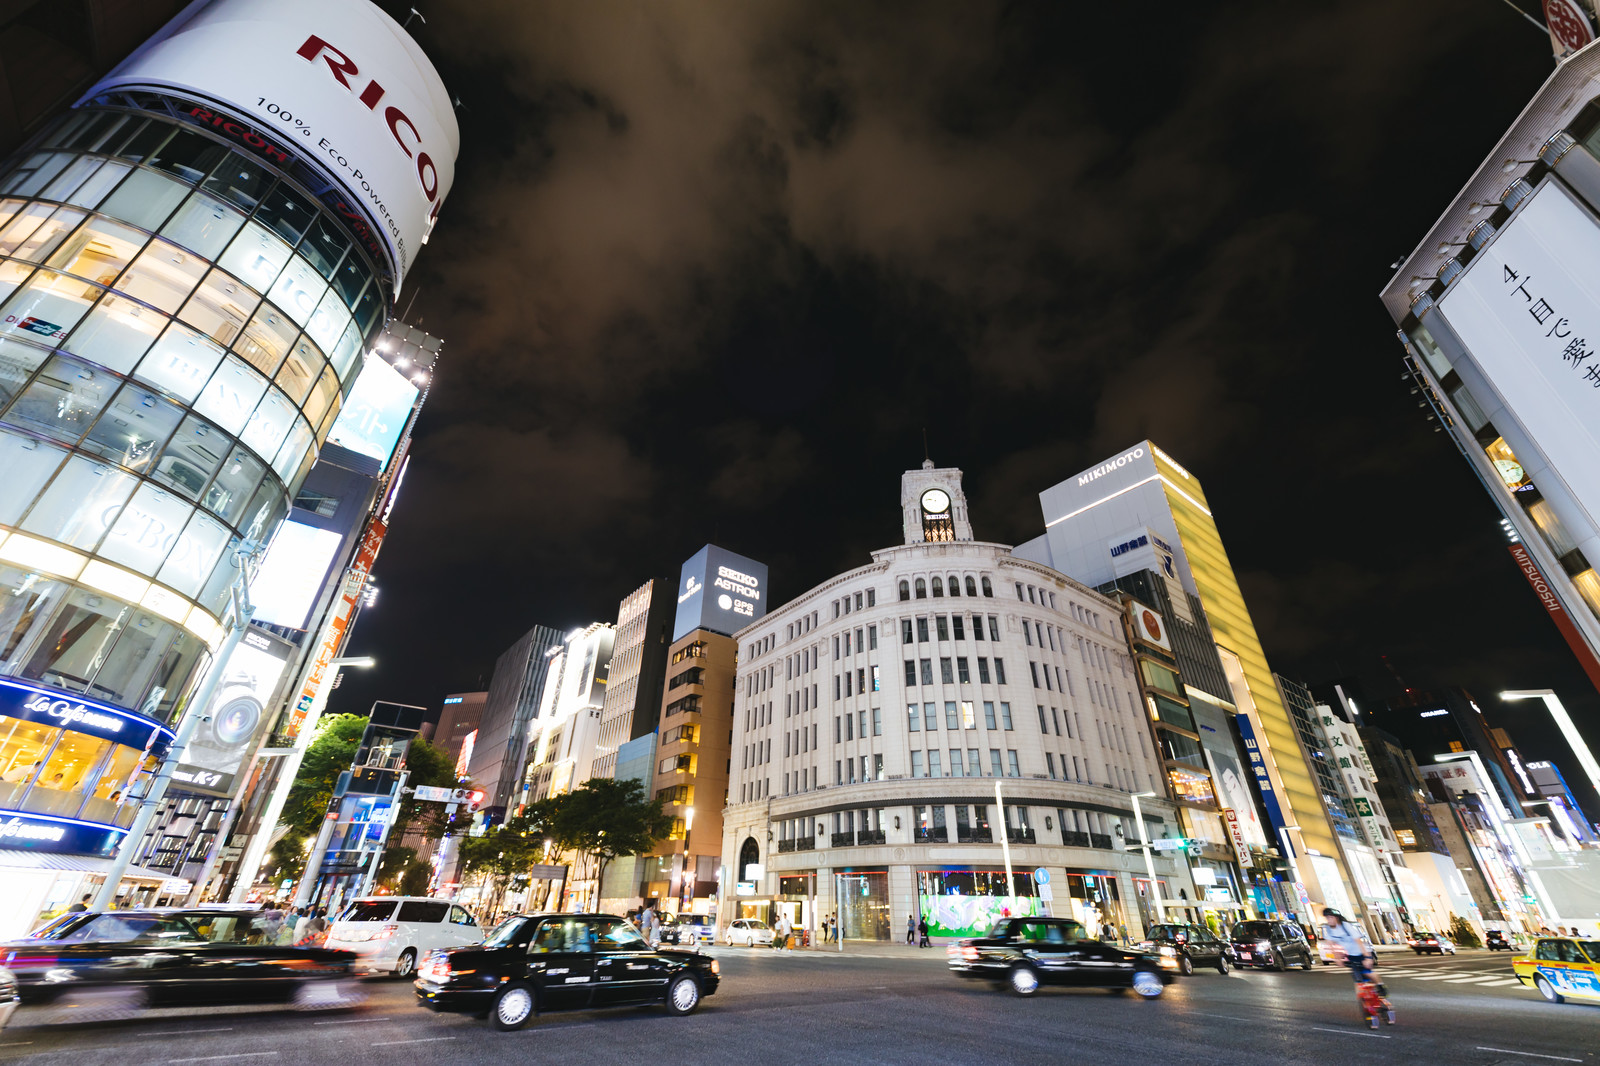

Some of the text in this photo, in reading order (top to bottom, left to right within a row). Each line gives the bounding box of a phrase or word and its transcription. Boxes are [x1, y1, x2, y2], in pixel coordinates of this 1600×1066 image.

[257, 97, 311, 137] 100%
[189, 107, 287, 163] RICOH
[1078, 448, 1144, 487] MIKIMOTO
[718, 566, 758, 588] SEIKO
[1513, 548, 1560, 611] MITSUKOSHI
[714, 577, 760, 600] ASTRON
[734, 599, 754, 611] GPS
[23, 696, 50, 712] Le
[1420, 708, 1449, 718] CHANEL
[192, 770, 222, 787] K-1
[1355, 800, 1370, 814] 本
